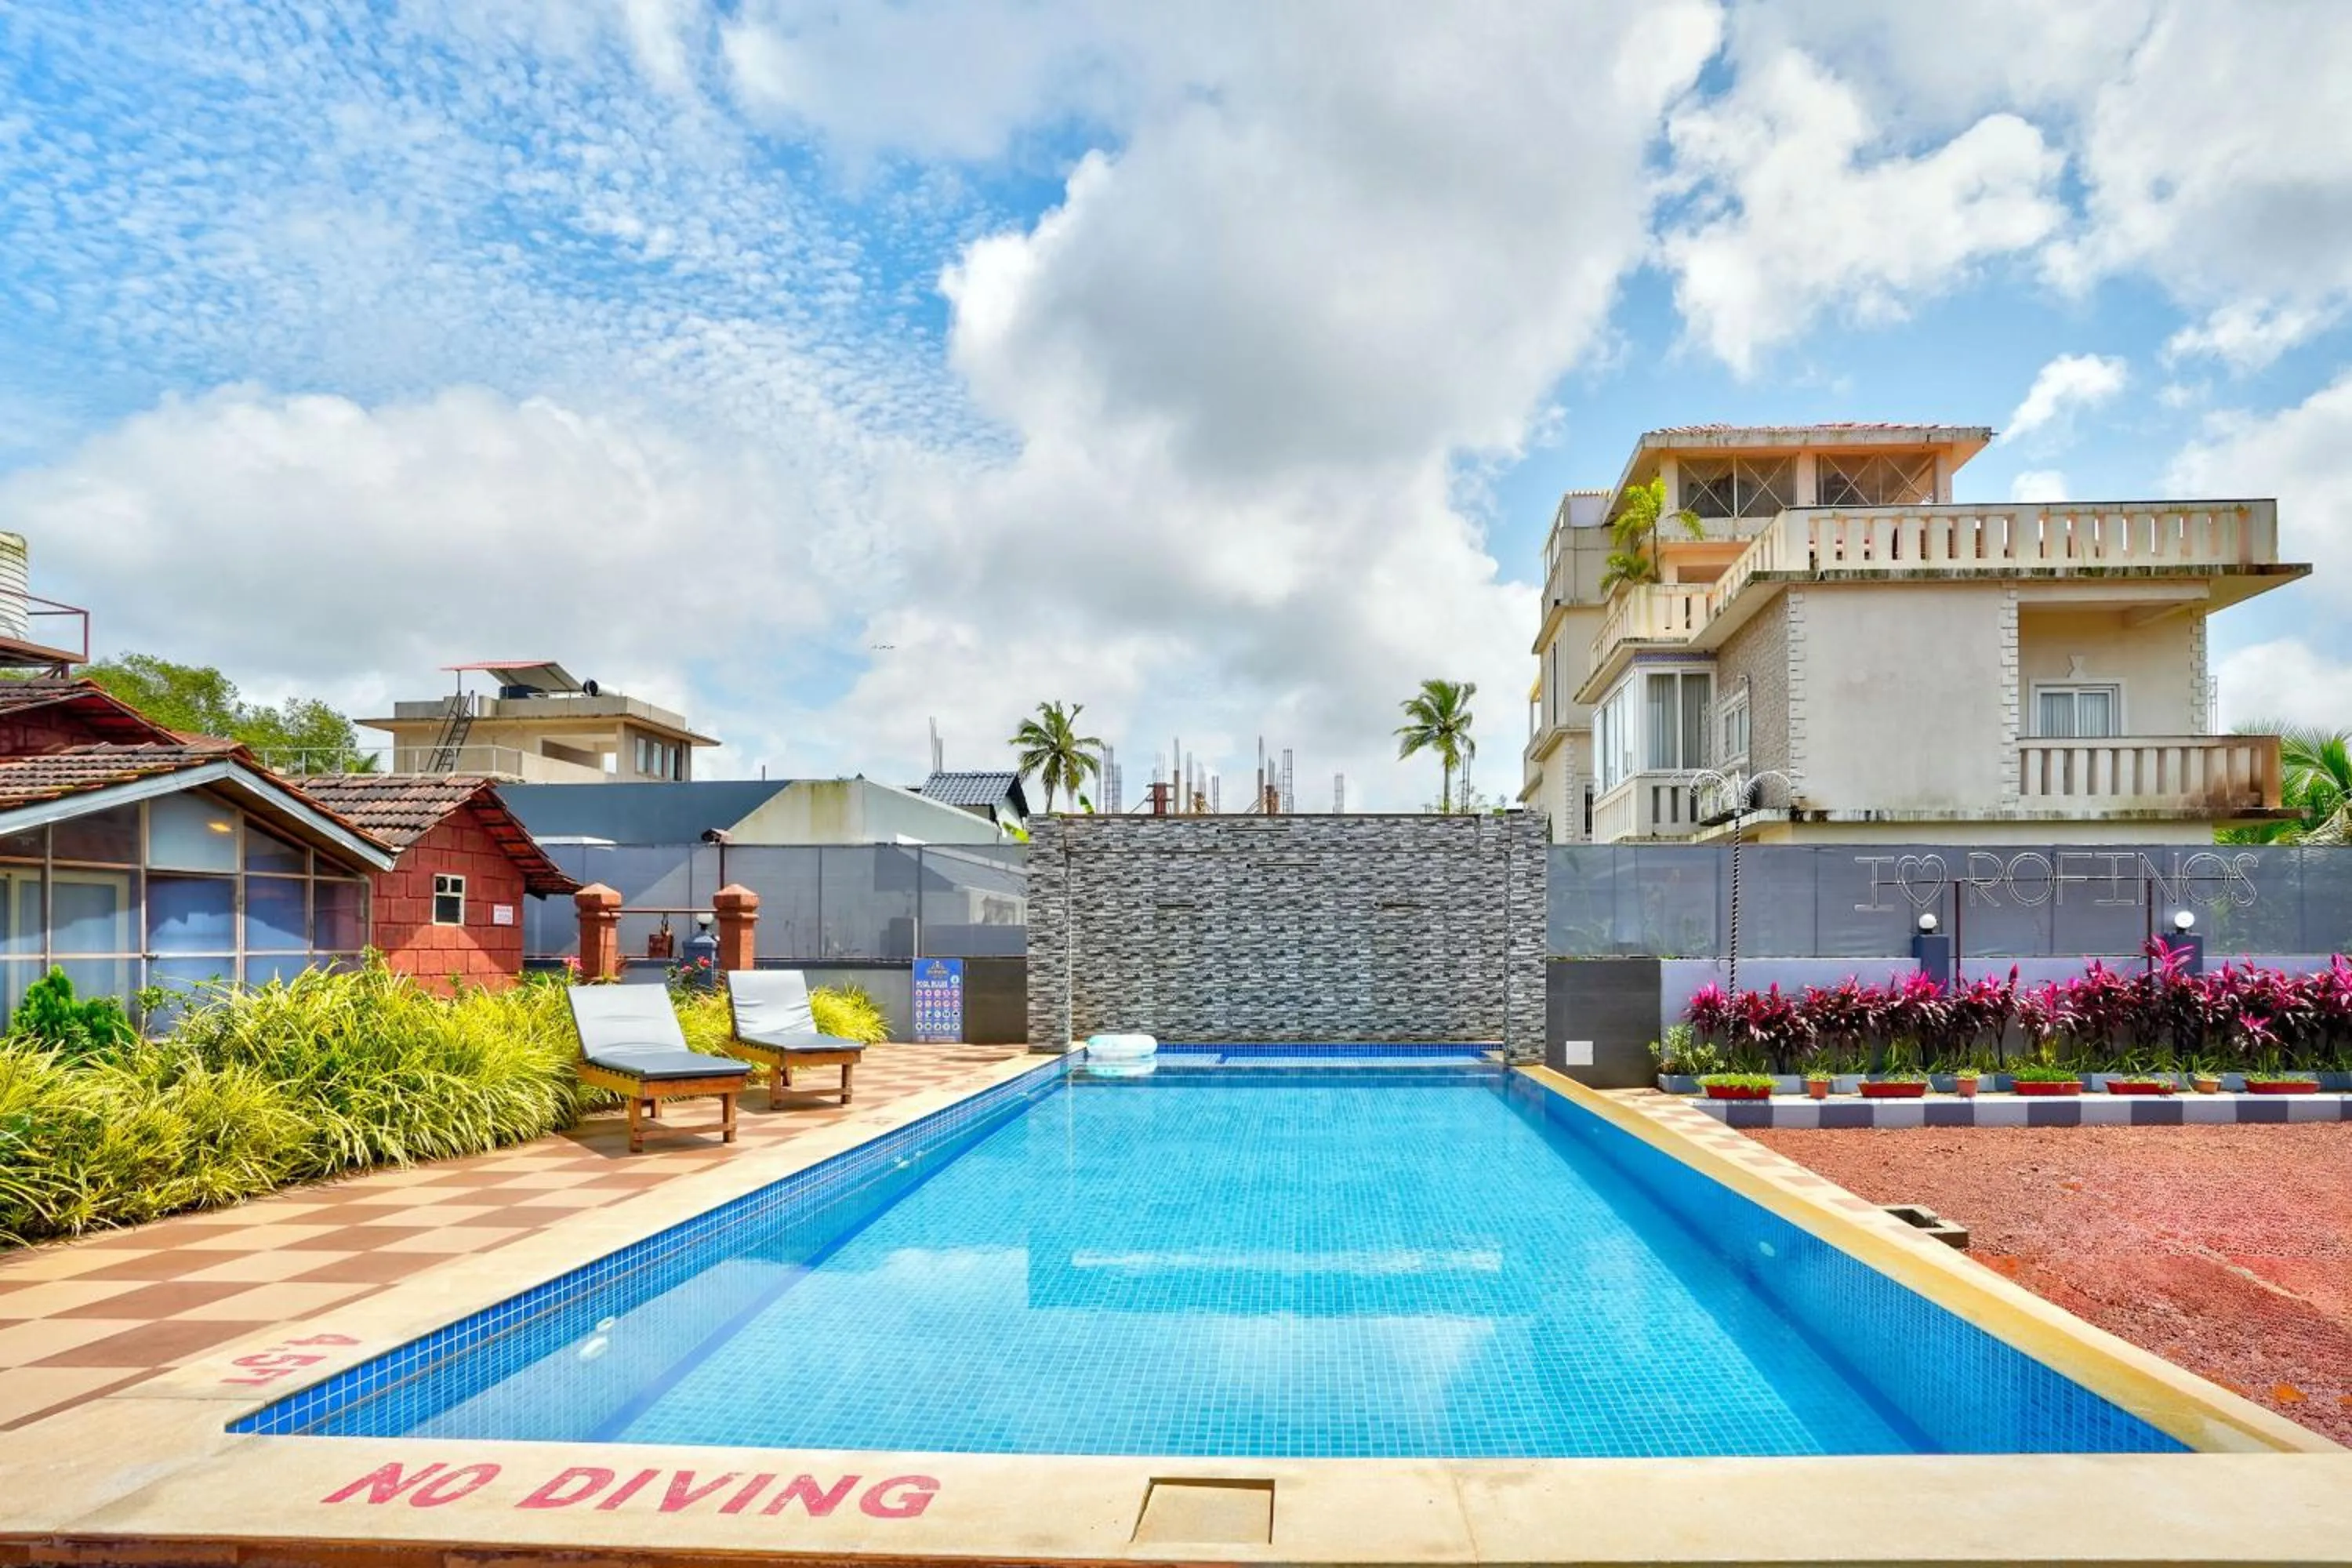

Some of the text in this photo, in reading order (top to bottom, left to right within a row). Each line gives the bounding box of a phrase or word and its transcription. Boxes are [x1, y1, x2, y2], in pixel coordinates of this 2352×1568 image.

[1854, 852, 2259, 911] I ROFINOS
[320, 1461, 942, 1519] NO DIVING
